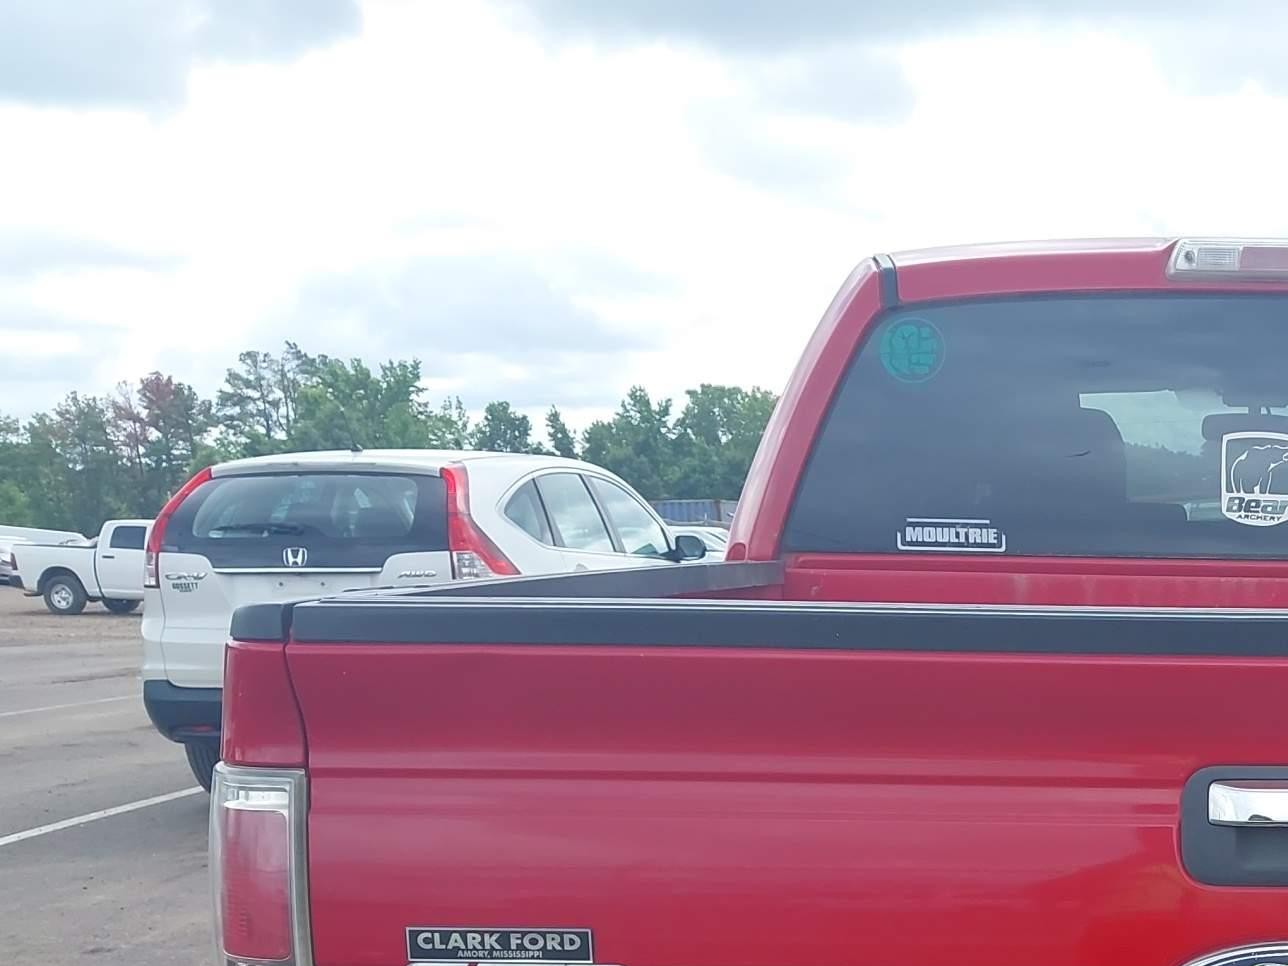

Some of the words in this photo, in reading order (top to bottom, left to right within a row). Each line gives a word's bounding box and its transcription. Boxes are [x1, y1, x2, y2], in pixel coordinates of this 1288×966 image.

[1236, 514, 1282, 522] ARCHERY
[905, 526, 998, 544] MOULTRIE
[416, 932, 501, 950] CLARK
[510, 933, 582, 951] FORD
